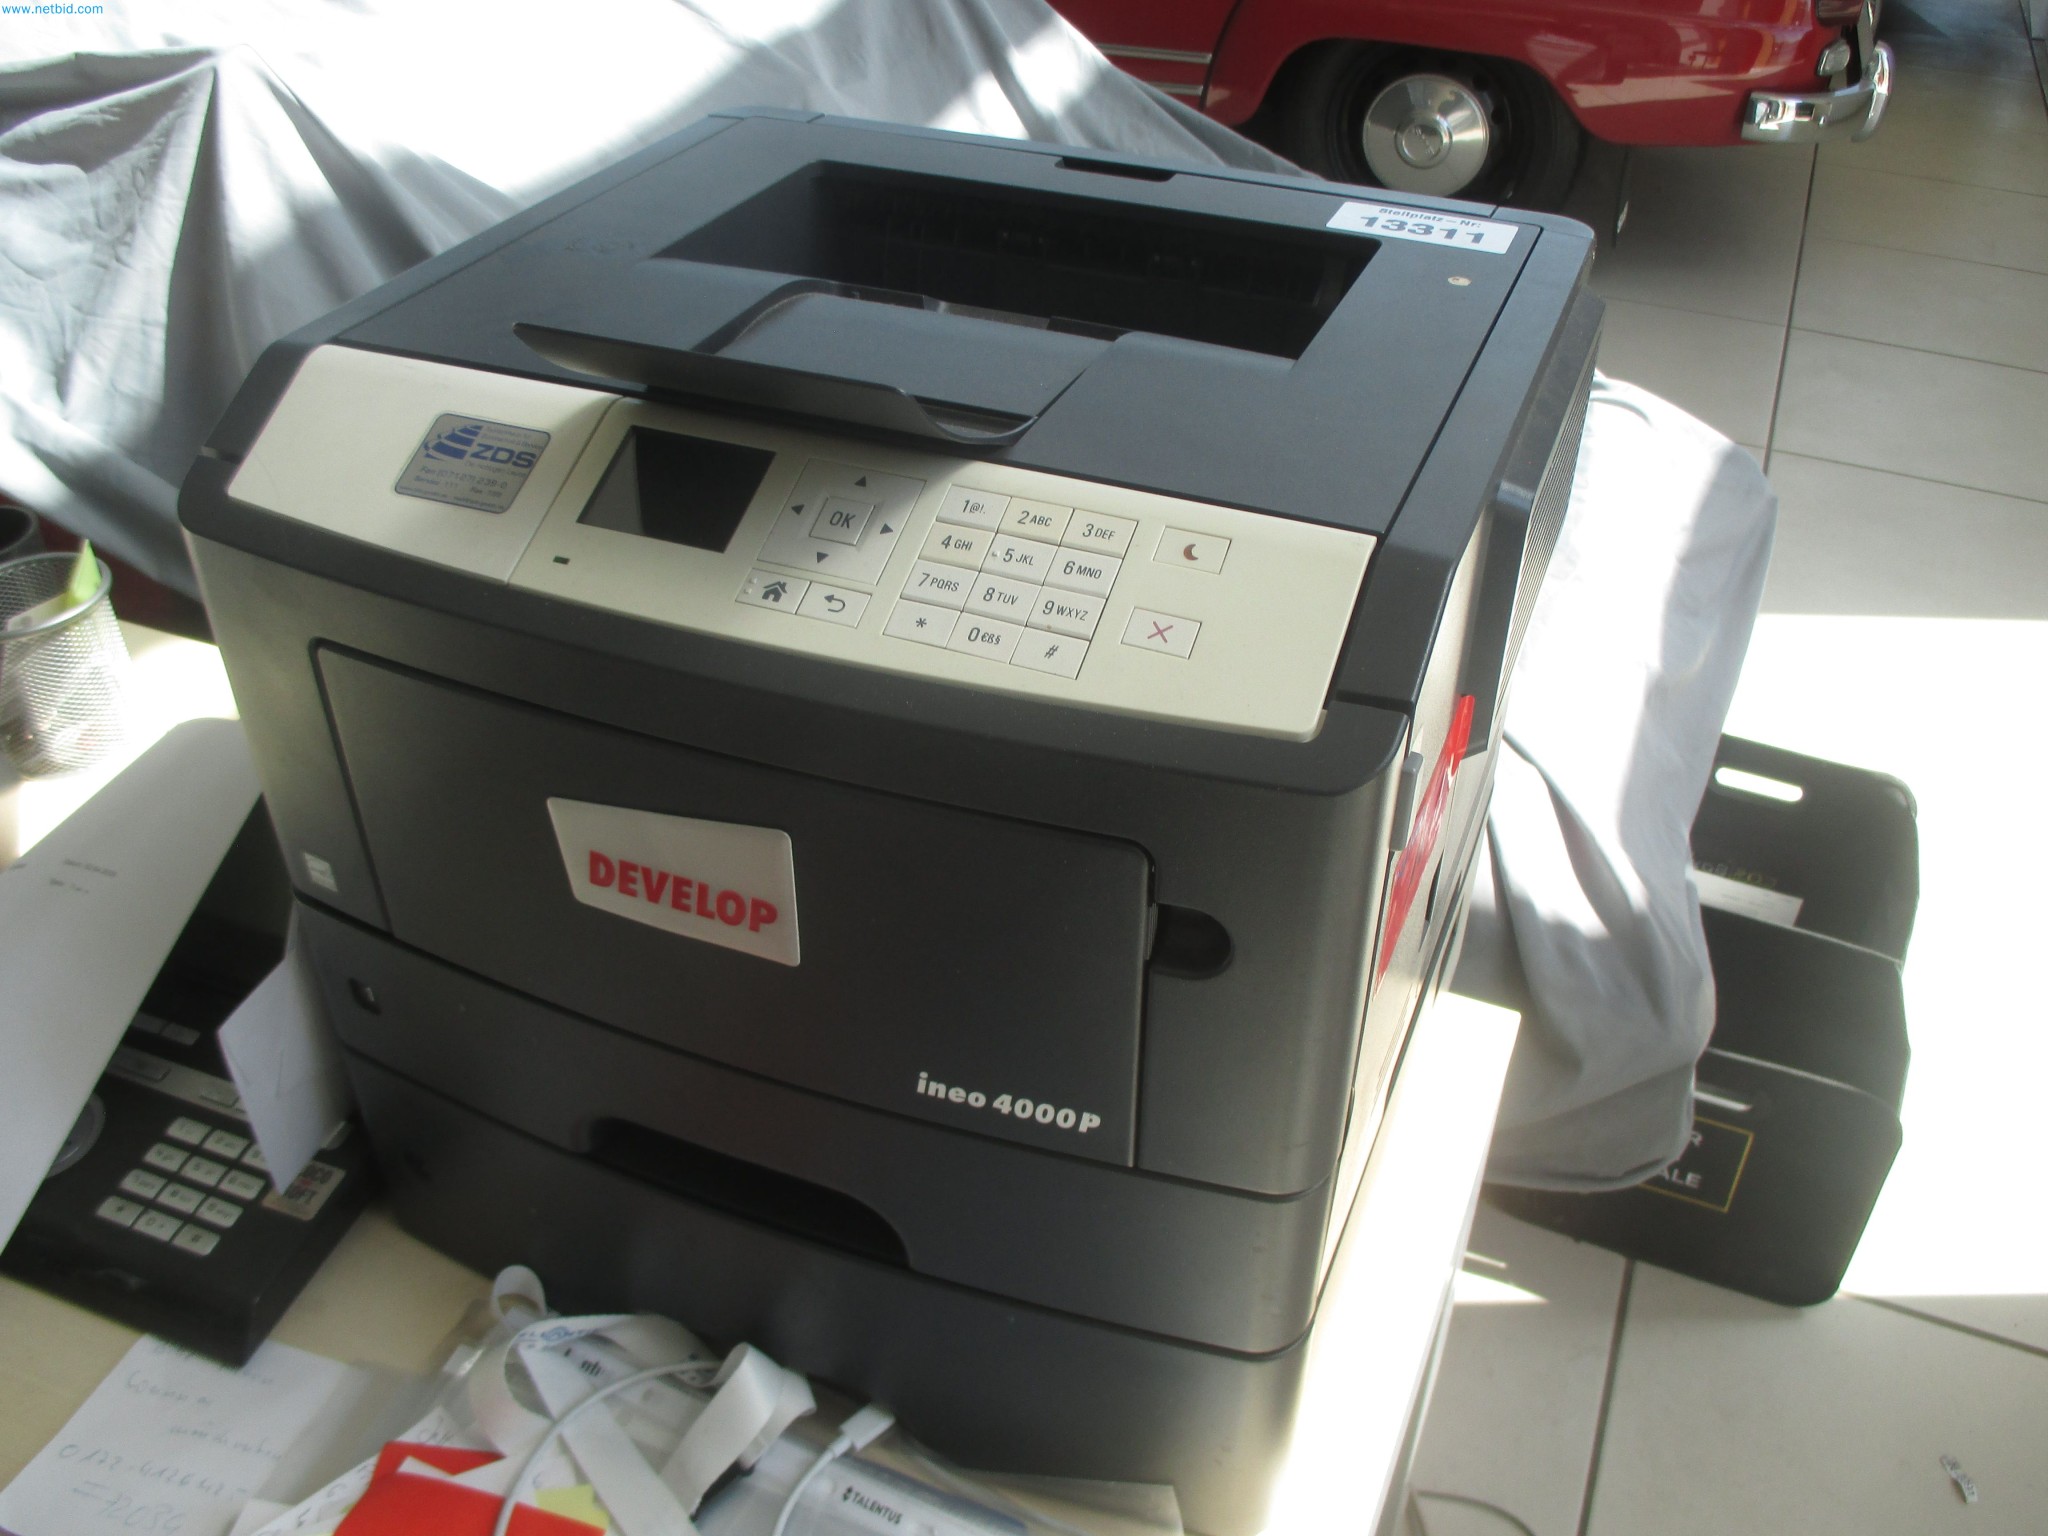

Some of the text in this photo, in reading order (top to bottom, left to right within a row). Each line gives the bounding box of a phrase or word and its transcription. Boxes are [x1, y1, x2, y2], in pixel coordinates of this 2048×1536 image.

[1378, 207, 1444, 223] Stellplatz
[1360, 216, 1485, 244] 13311
[470, 443, 537, 468] ZDS
[829, 511, 856, 528] OK
[588, 849, 778, 932] DEVELOP
[916, 1071, 1101, 1133] ineo 4000P
[1661, 1167, 1702, 1188] ALE
[852, 1491, 902, 1524] TALENTUS
